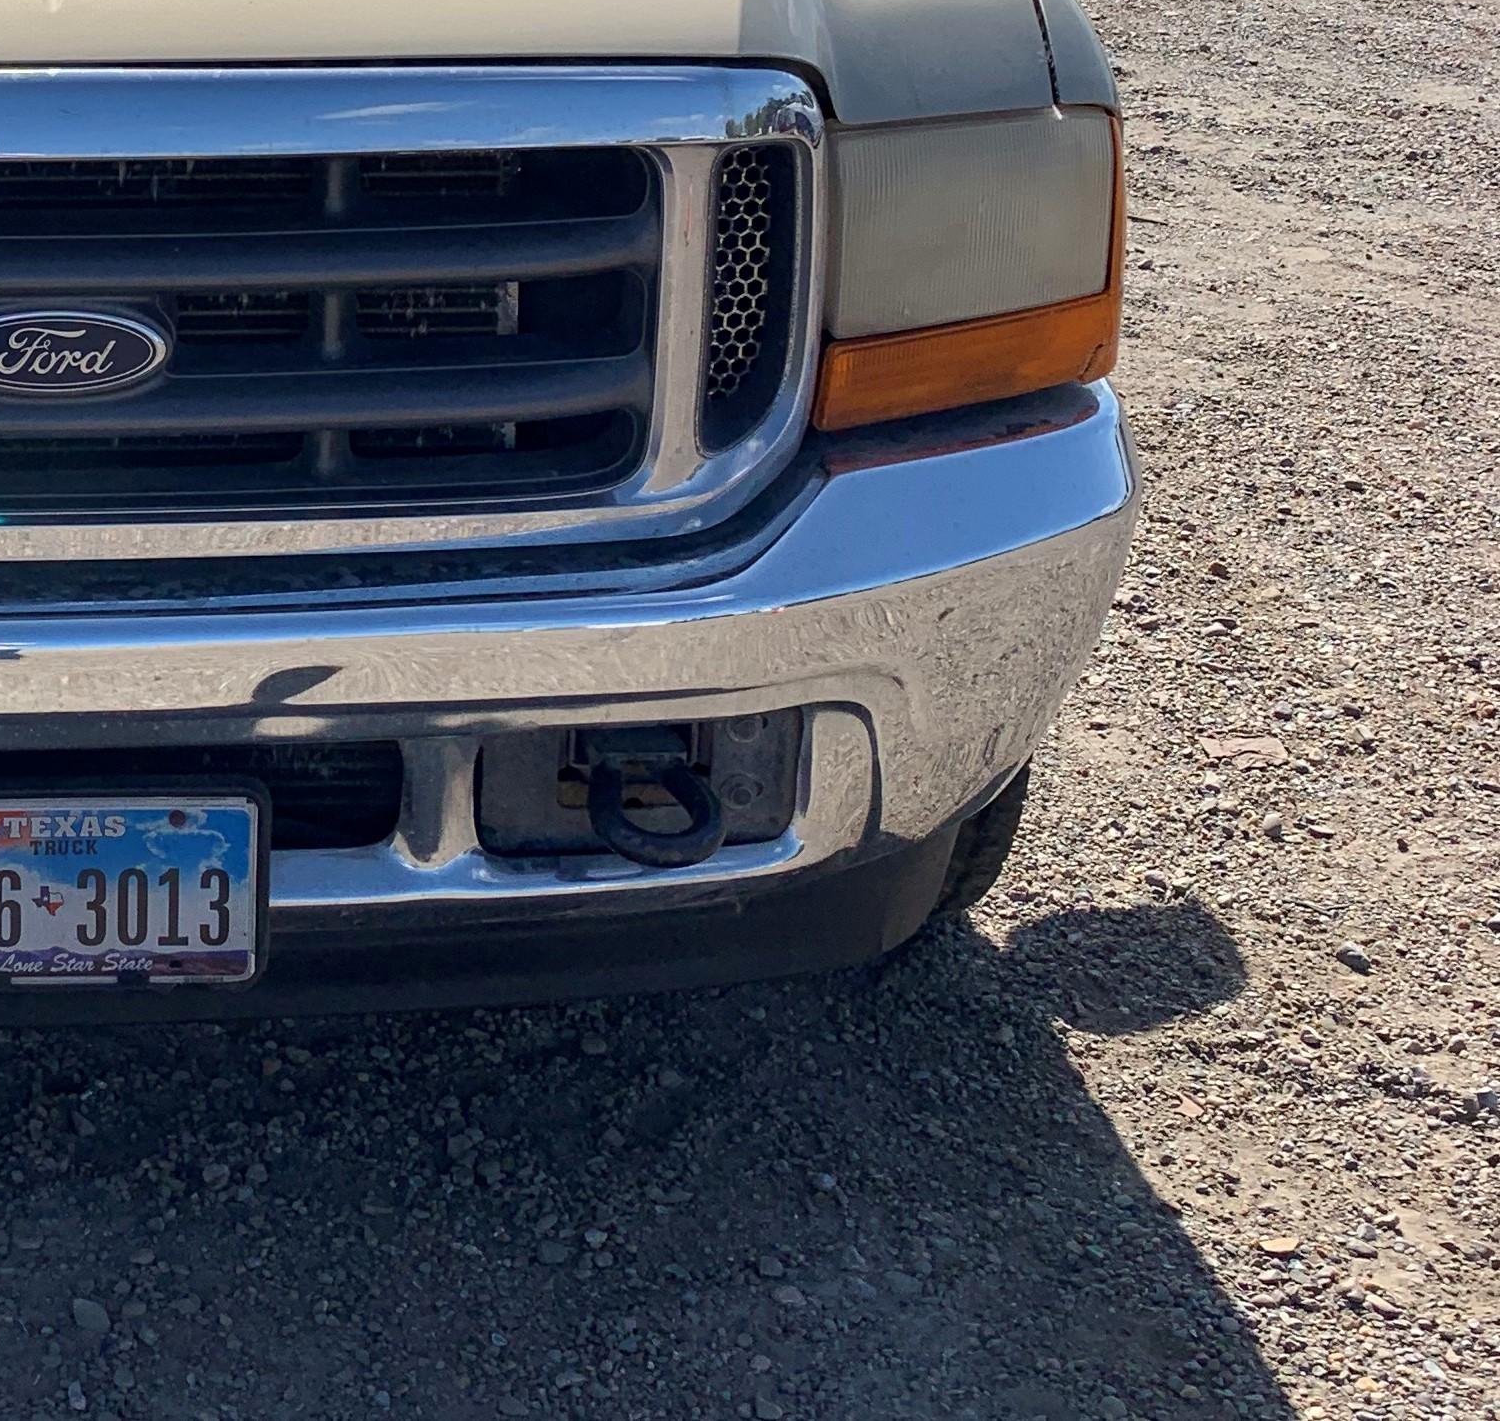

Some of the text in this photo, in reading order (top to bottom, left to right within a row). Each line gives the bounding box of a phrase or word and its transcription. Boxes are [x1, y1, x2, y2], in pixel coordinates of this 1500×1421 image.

[3, 816, 127, 839] TEXAS
[29, 840, 99, 856] TRUCK
[76, 867, 230, 948] 3013
[50, 953, 94, 973] Star
[100, 954, 154, 973] State
